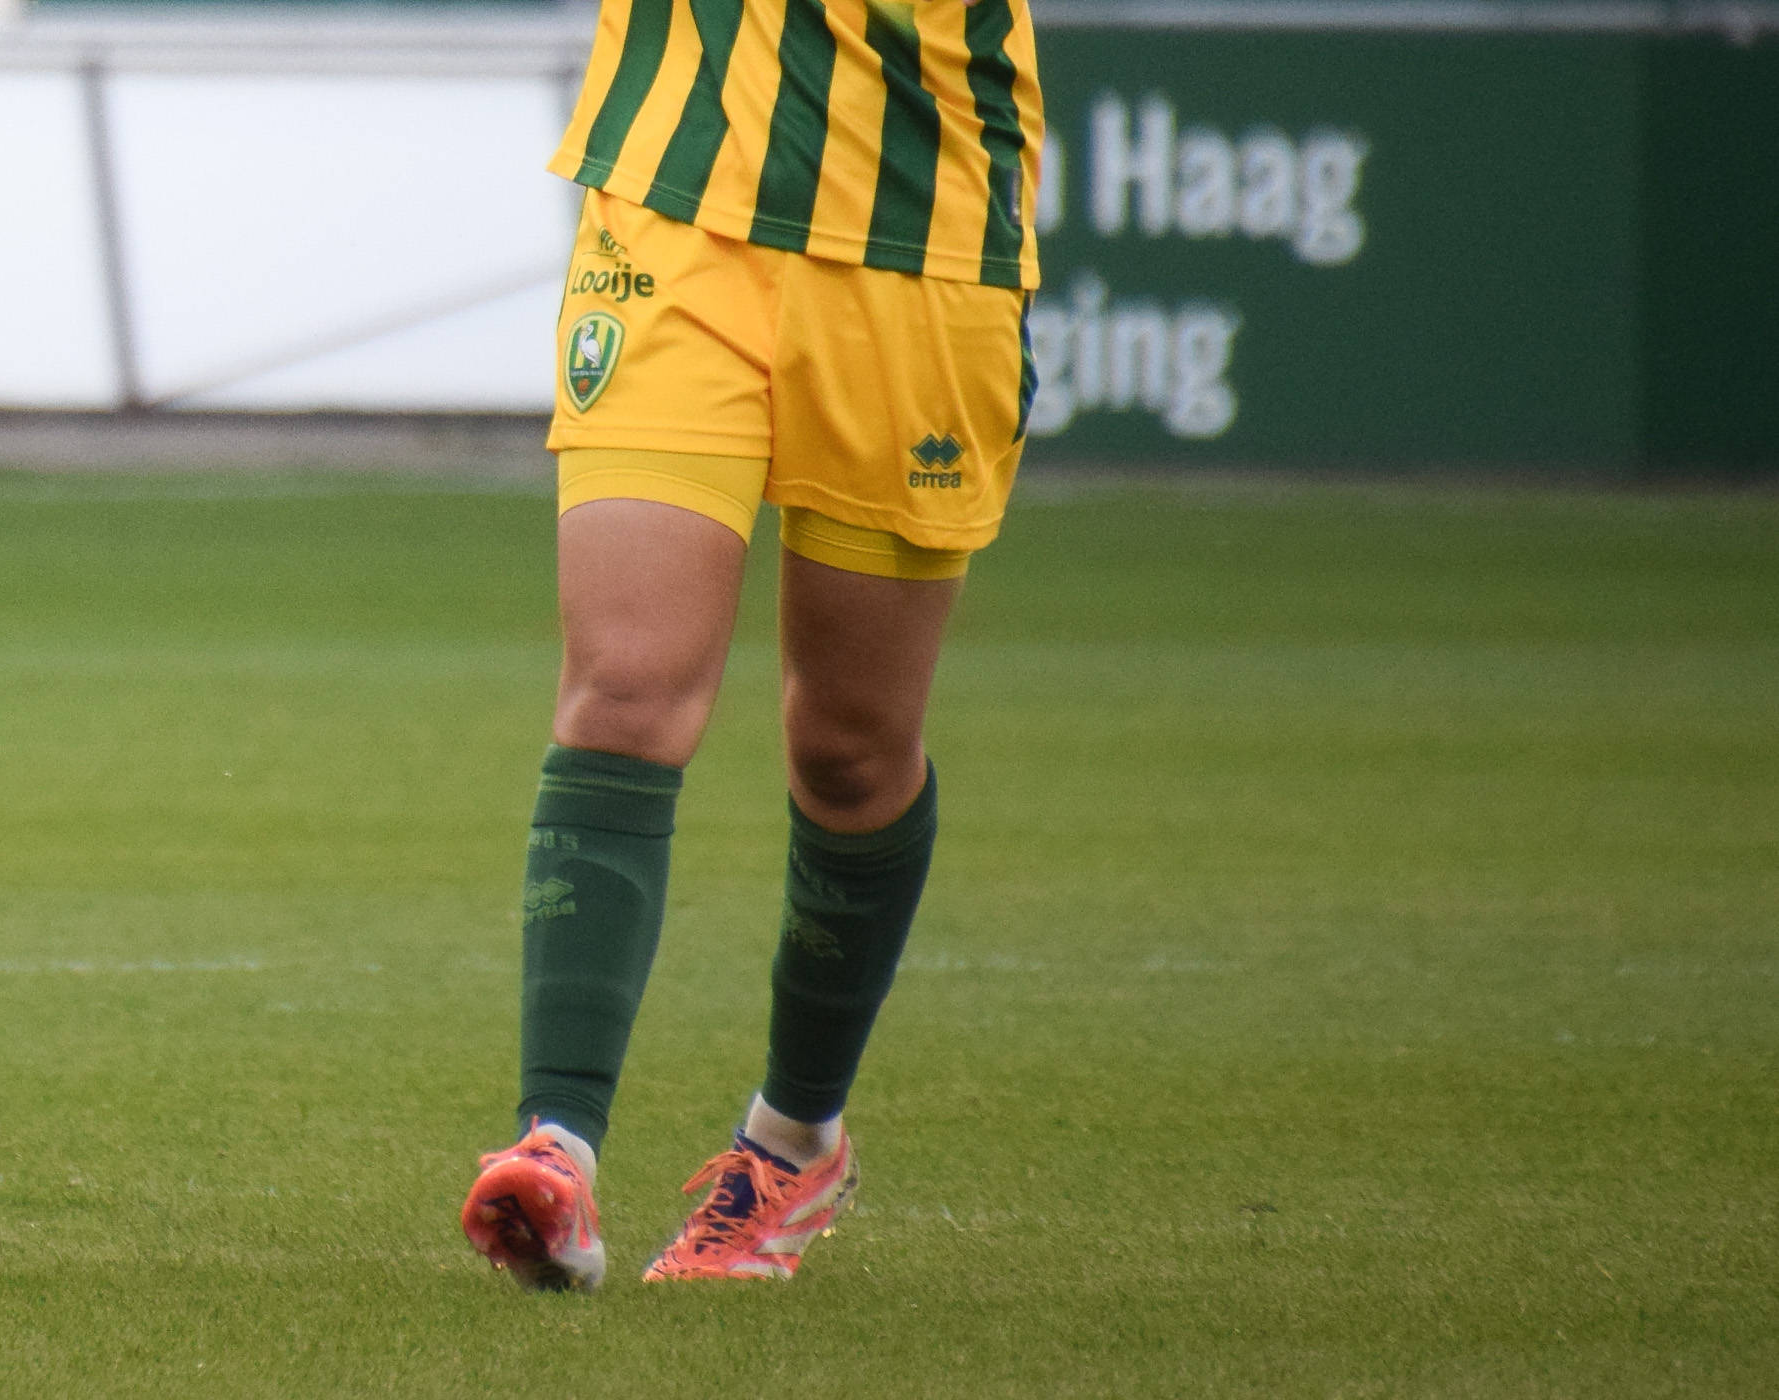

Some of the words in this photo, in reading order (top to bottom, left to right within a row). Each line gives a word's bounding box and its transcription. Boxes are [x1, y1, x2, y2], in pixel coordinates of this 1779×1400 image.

[1088, 94, 1369, 264] Haag
[571, 262, 655, 303] Looije
[909, 471, 961, 489] errea
